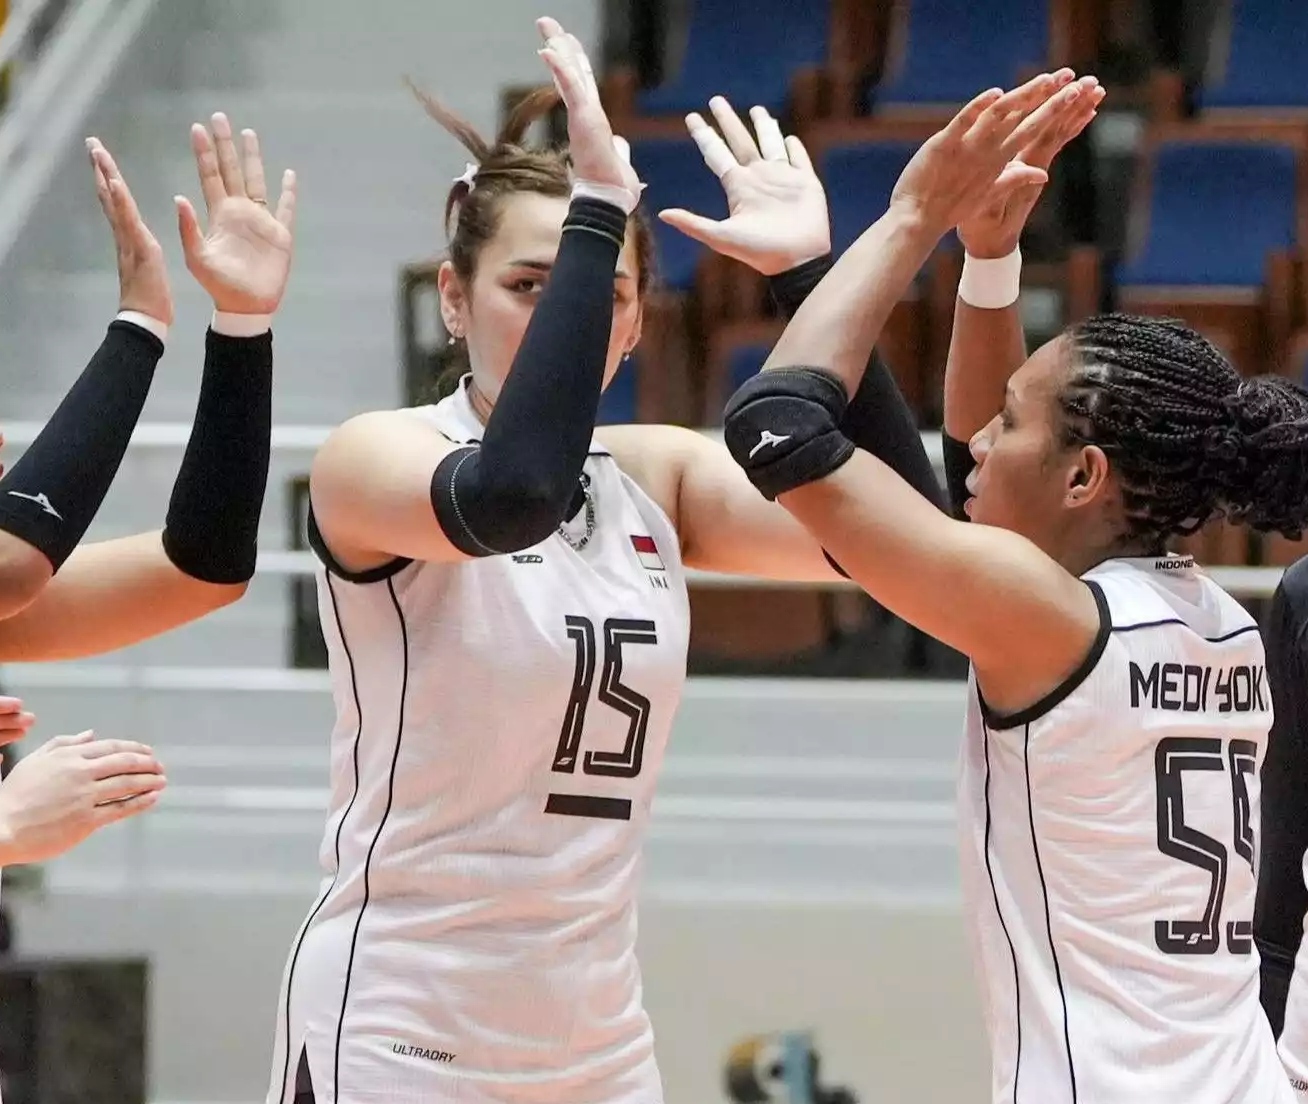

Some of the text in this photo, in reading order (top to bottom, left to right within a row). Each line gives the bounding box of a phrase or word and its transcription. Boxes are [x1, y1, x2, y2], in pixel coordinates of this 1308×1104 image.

[551, 614, 658, 778] 15
[1214, 664, 1269, 712] YOK
[392, 1043, 456, 1063] ULTRADRY
